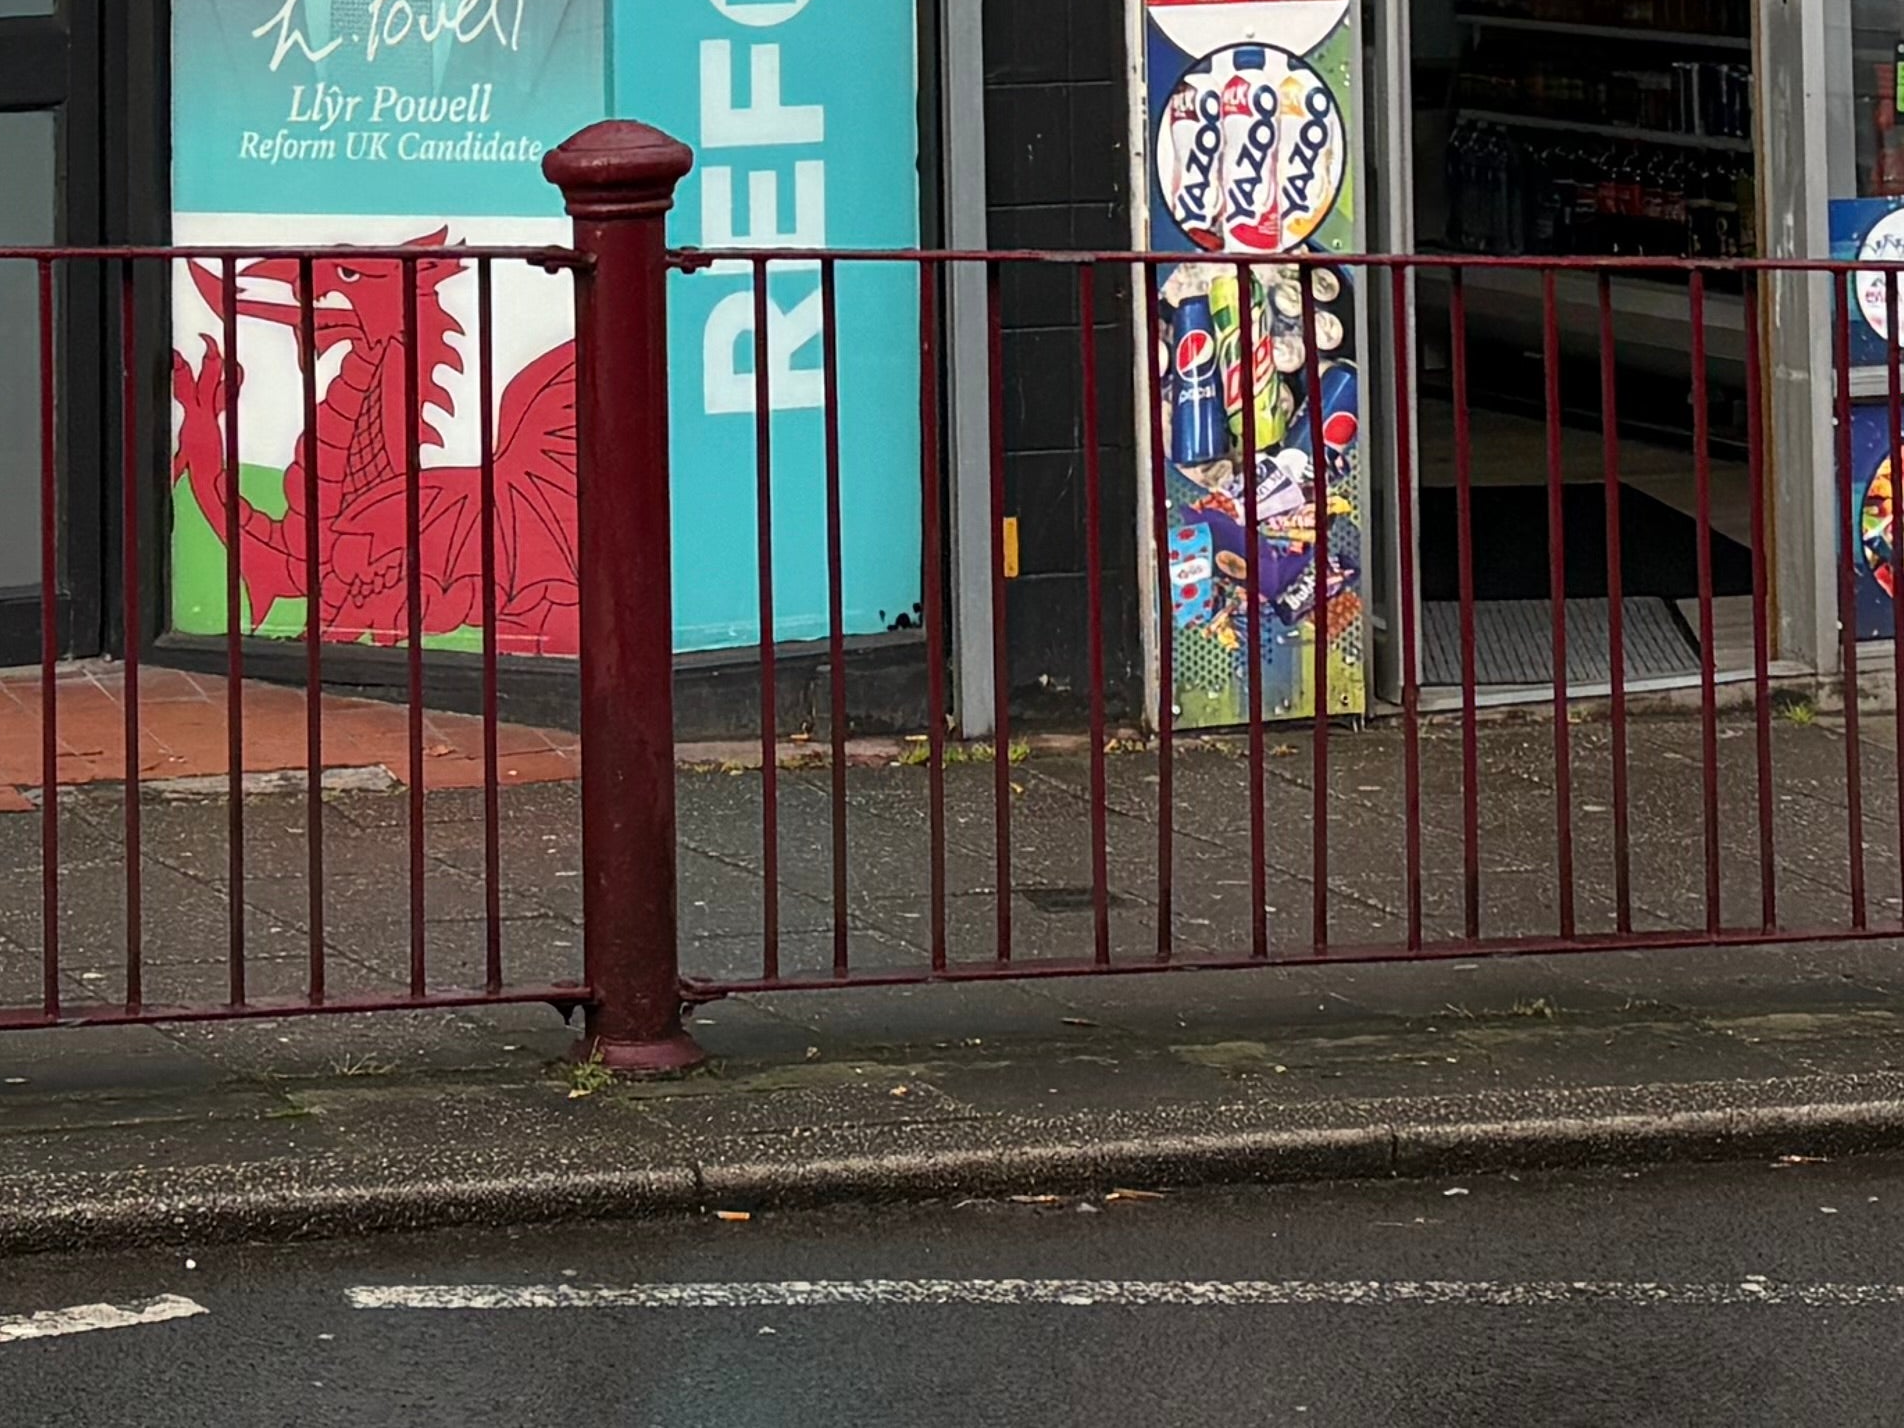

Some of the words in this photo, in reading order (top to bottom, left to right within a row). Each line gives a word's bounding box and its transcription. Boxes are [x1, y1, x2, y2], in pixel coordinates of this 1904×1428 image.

[238, 128, 337, 165] Reform
[346, 131, 391, 161] UK
[397, 131, 543, 161] Candidate
[287, 81, 363, 132] Llŷr
[368, 82, 493, 123] Powell
[1175, 89, 1222, 224] YAZOO
[1226, 83, 1279, 224] YAZOO
[1279, 86, 1332, 220] YAZOO
[1178, 383, 1217, 407] pepsi
